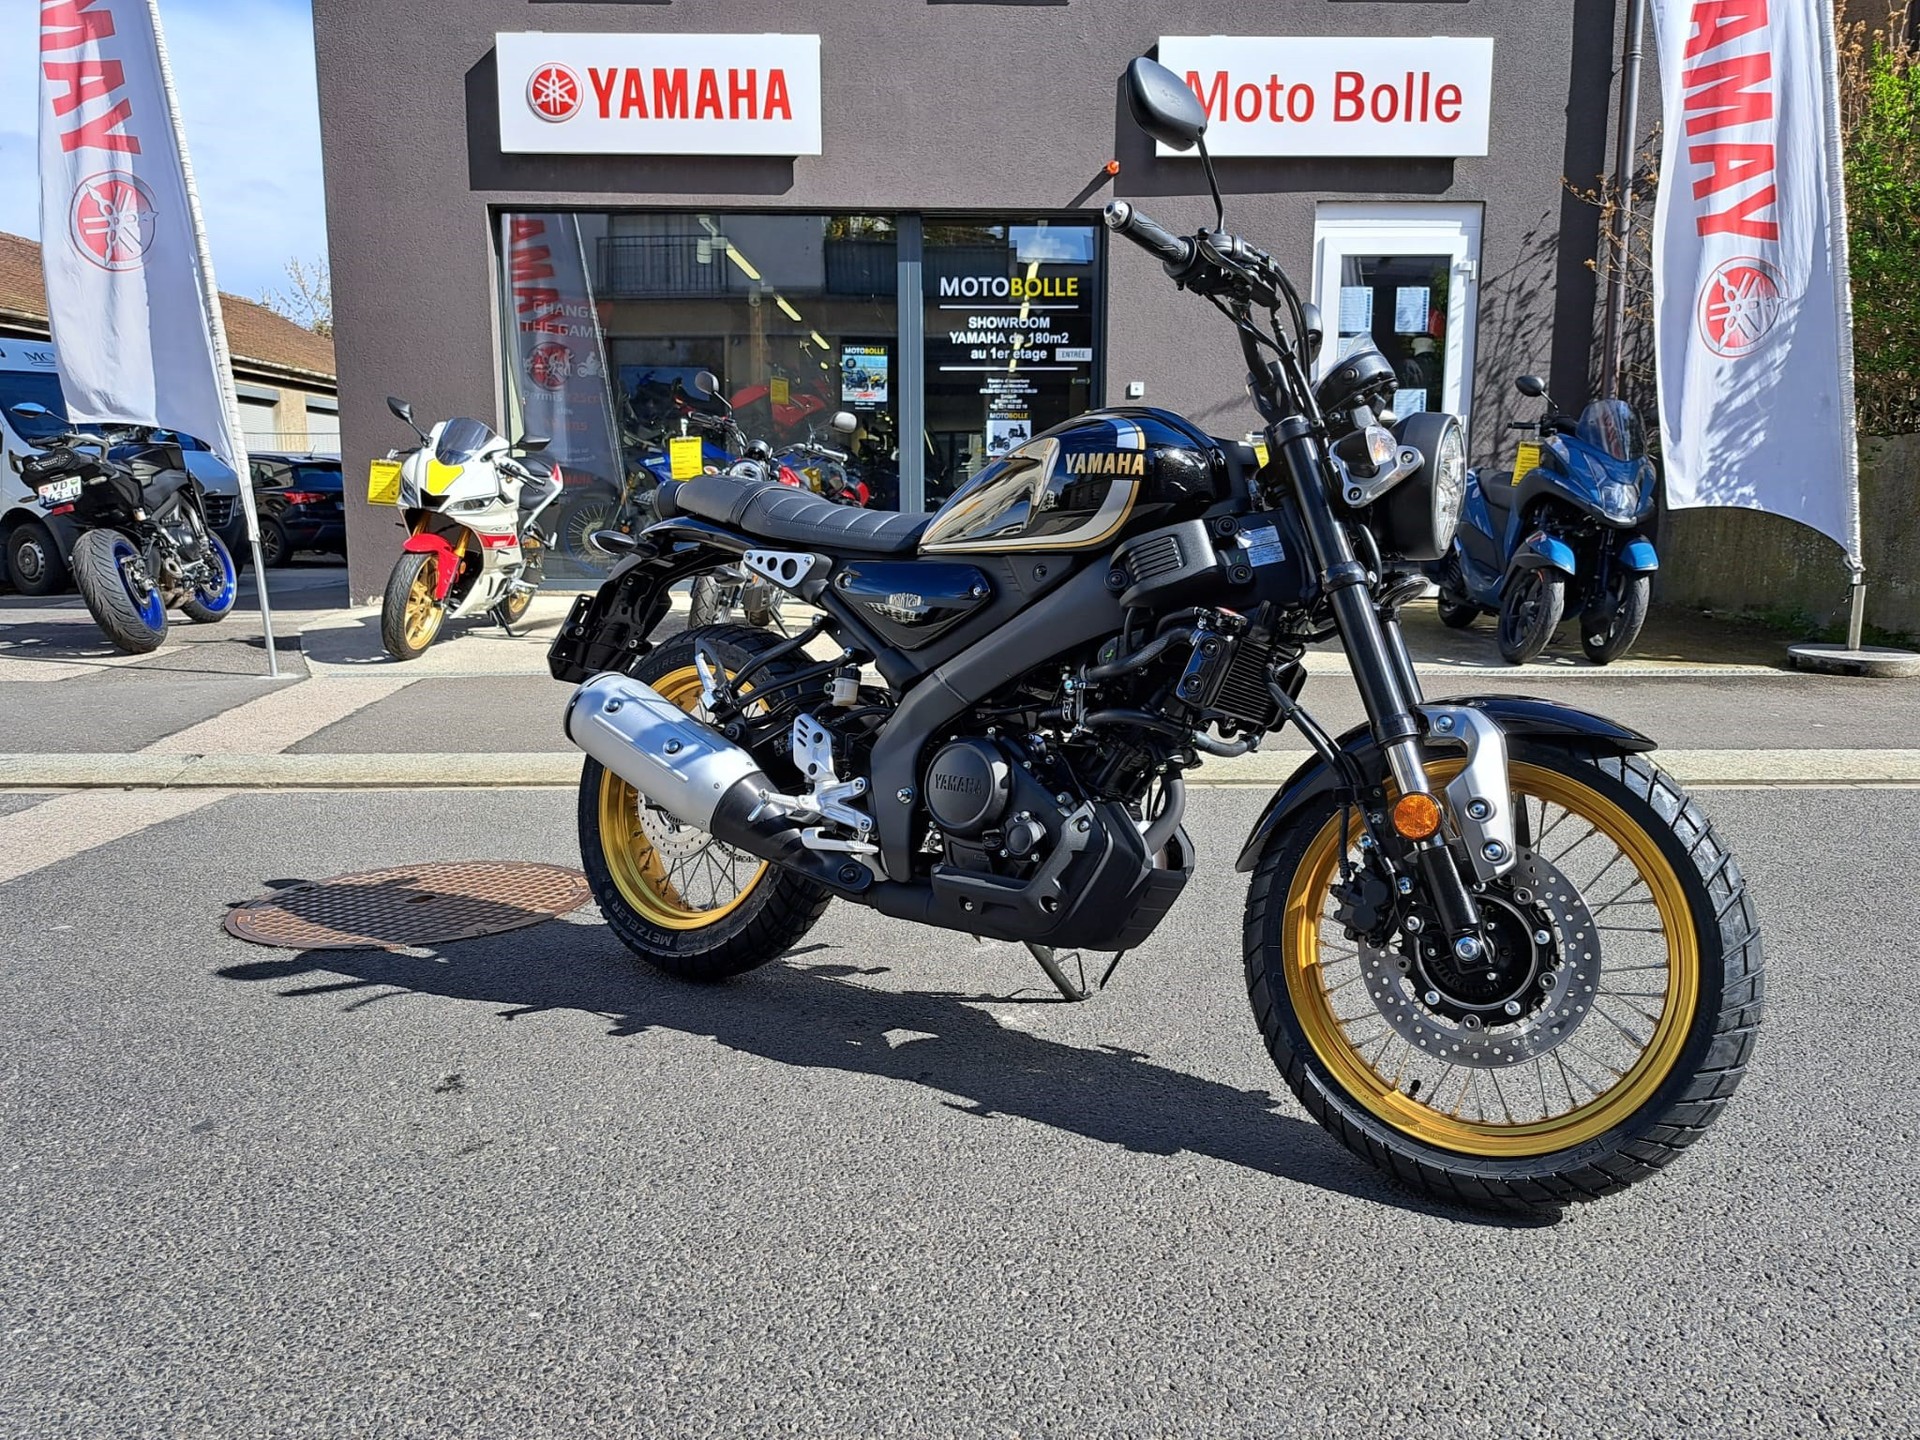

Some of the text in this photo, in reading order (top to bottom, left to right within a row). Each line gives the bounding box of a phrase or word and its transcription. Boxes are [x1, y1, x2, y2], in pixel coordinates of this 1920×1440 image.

[587, 67, 793, 120] YAMAHA
[1185, 70, 1463, 123] Moto Bolle
[939, 276, 1079, 297] MOTOBOLLE
[968, 316, 1050, 329] SHOWROOM
[949, 331, 1070, 344] YAMAHA de 180m2
[970, 349, 987, 359] au
[989, 347, 1009, 359] 1er
[1065, 452, 1145, 476] YAMAHA
[935, 773, 983, 795] YAMAHA
[611, 899, 674, 947] METZELER
